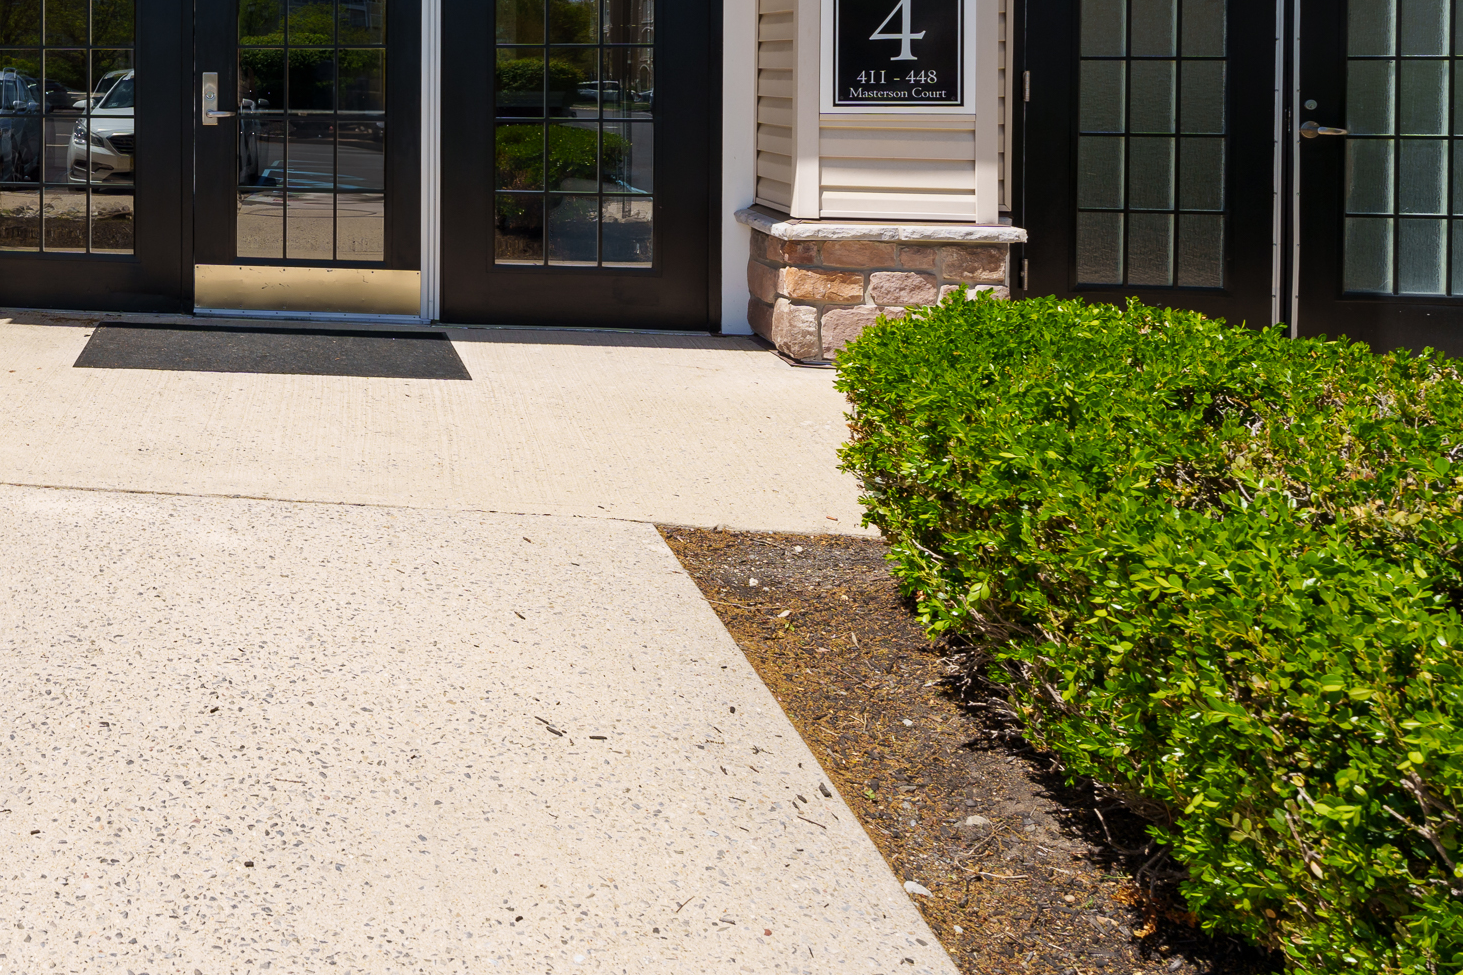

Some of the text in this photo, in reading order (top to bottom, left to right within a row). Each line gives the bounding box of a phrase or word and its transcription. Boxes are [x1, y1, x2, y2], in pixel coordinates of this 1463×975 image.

[856, 70, 887, 84] 411
[905, 69, 938, 84] 448
[849, 87, 947, 98] Masterson Court
